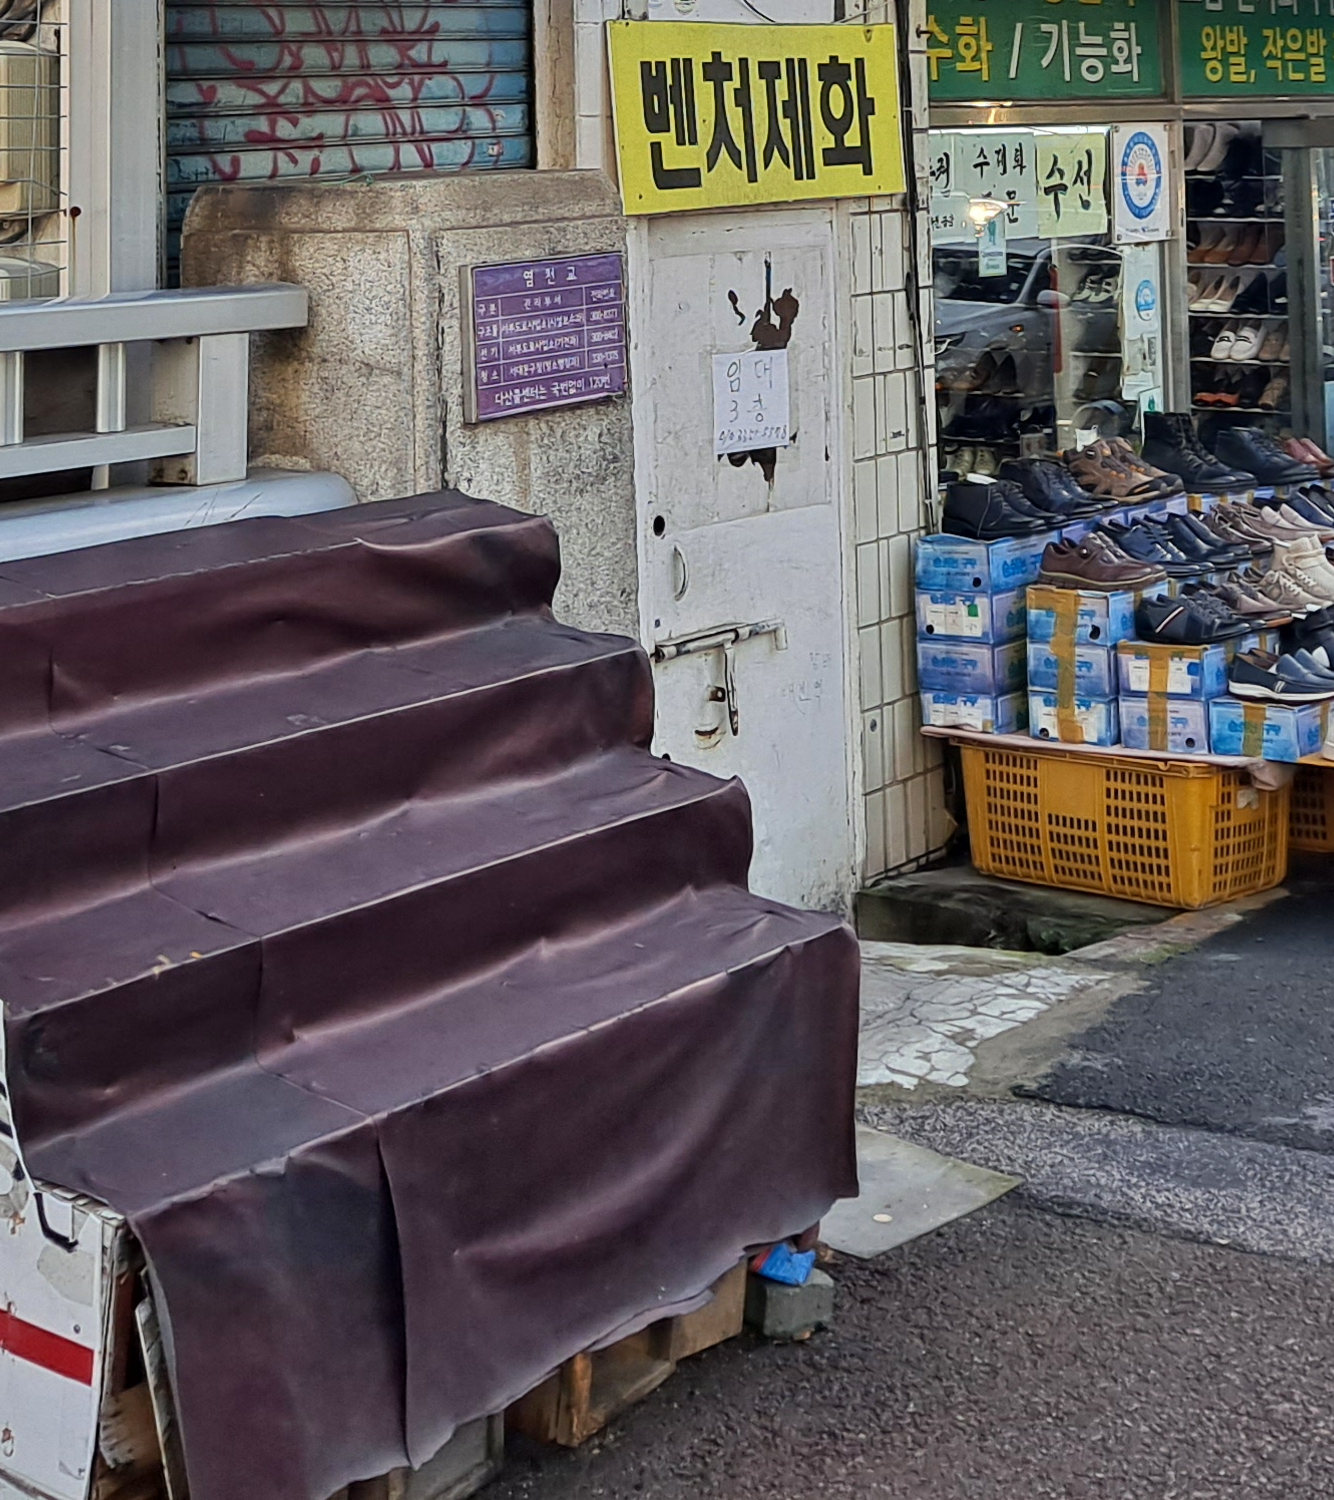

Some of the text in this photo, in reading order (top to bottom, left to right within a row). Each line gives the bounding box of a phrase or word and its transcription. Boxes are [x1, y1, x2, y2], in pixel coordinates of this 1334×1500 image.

[1040, 19, 1142, 83] 기능화
[1262, 27, 1327, 82] 작은발
[640, 51, 875, 190] 벤처제화
